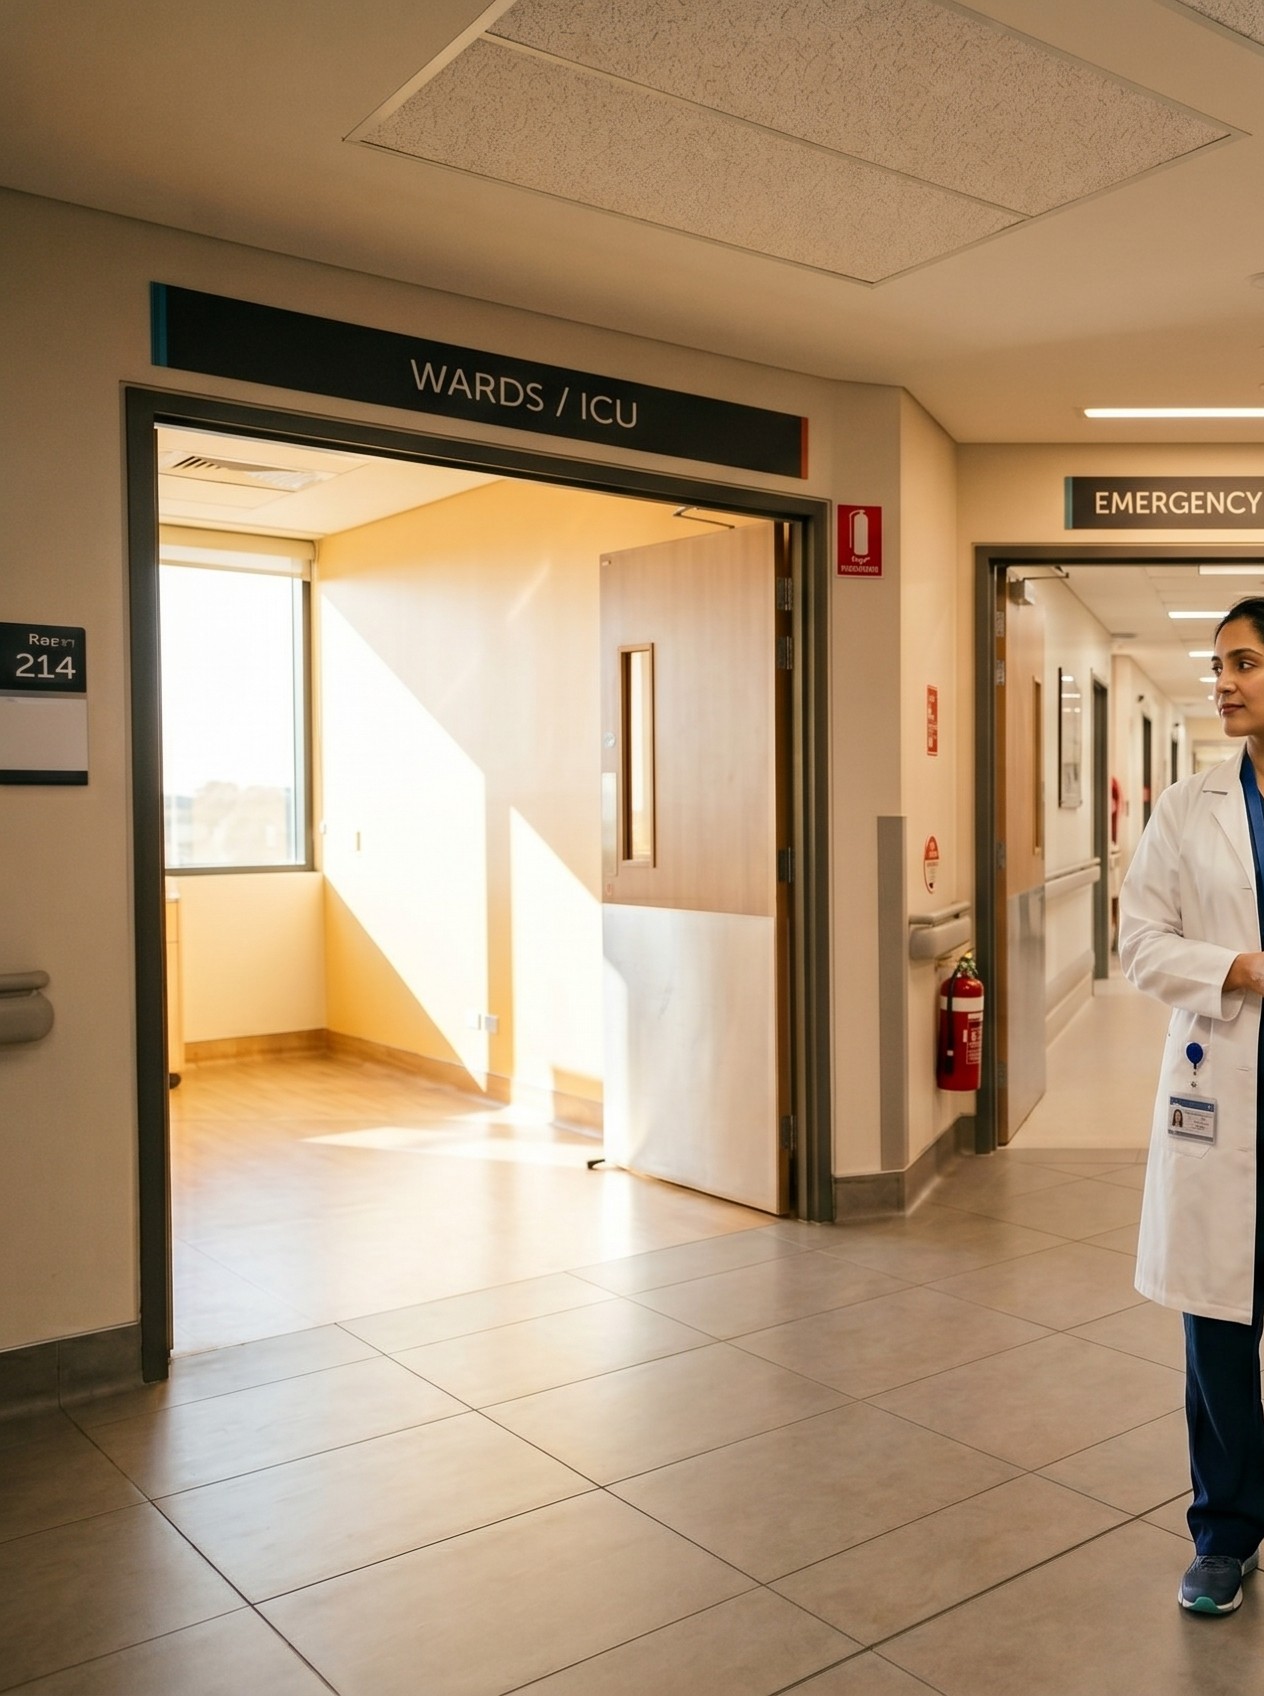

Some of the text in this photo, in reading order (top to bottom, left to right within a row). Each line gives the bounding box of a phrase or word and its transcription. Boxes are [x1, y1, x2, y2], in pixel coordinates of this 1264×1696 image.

[410, 358, 638, 429] WARDS / ICU
[1094, 490, 1263, 516] EMERGENCY
[15, 652, 77, 680] 214
